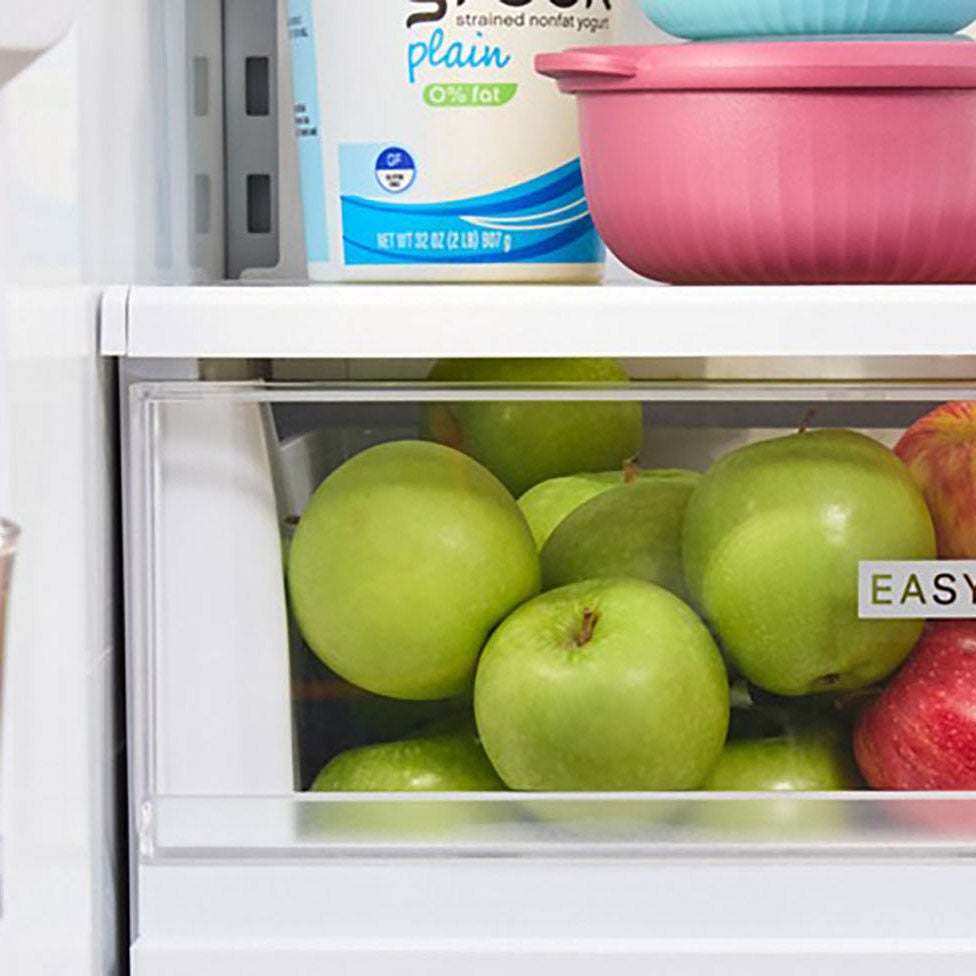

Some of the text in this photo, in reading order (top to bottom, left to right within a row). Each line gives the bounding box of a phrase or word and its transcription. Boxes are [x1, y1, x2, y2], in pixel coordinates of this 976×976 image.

[456, 13, 525, 27] strained
[529, 13, 574, 27] nonfat
[576, 16, 609, 33] yogurt
[407, 28, 511, 83] plain
[429, 86, 501, 103] 0% fat
[376, 232, 395, 249] NET
[396, 232, 412, 249] WT
